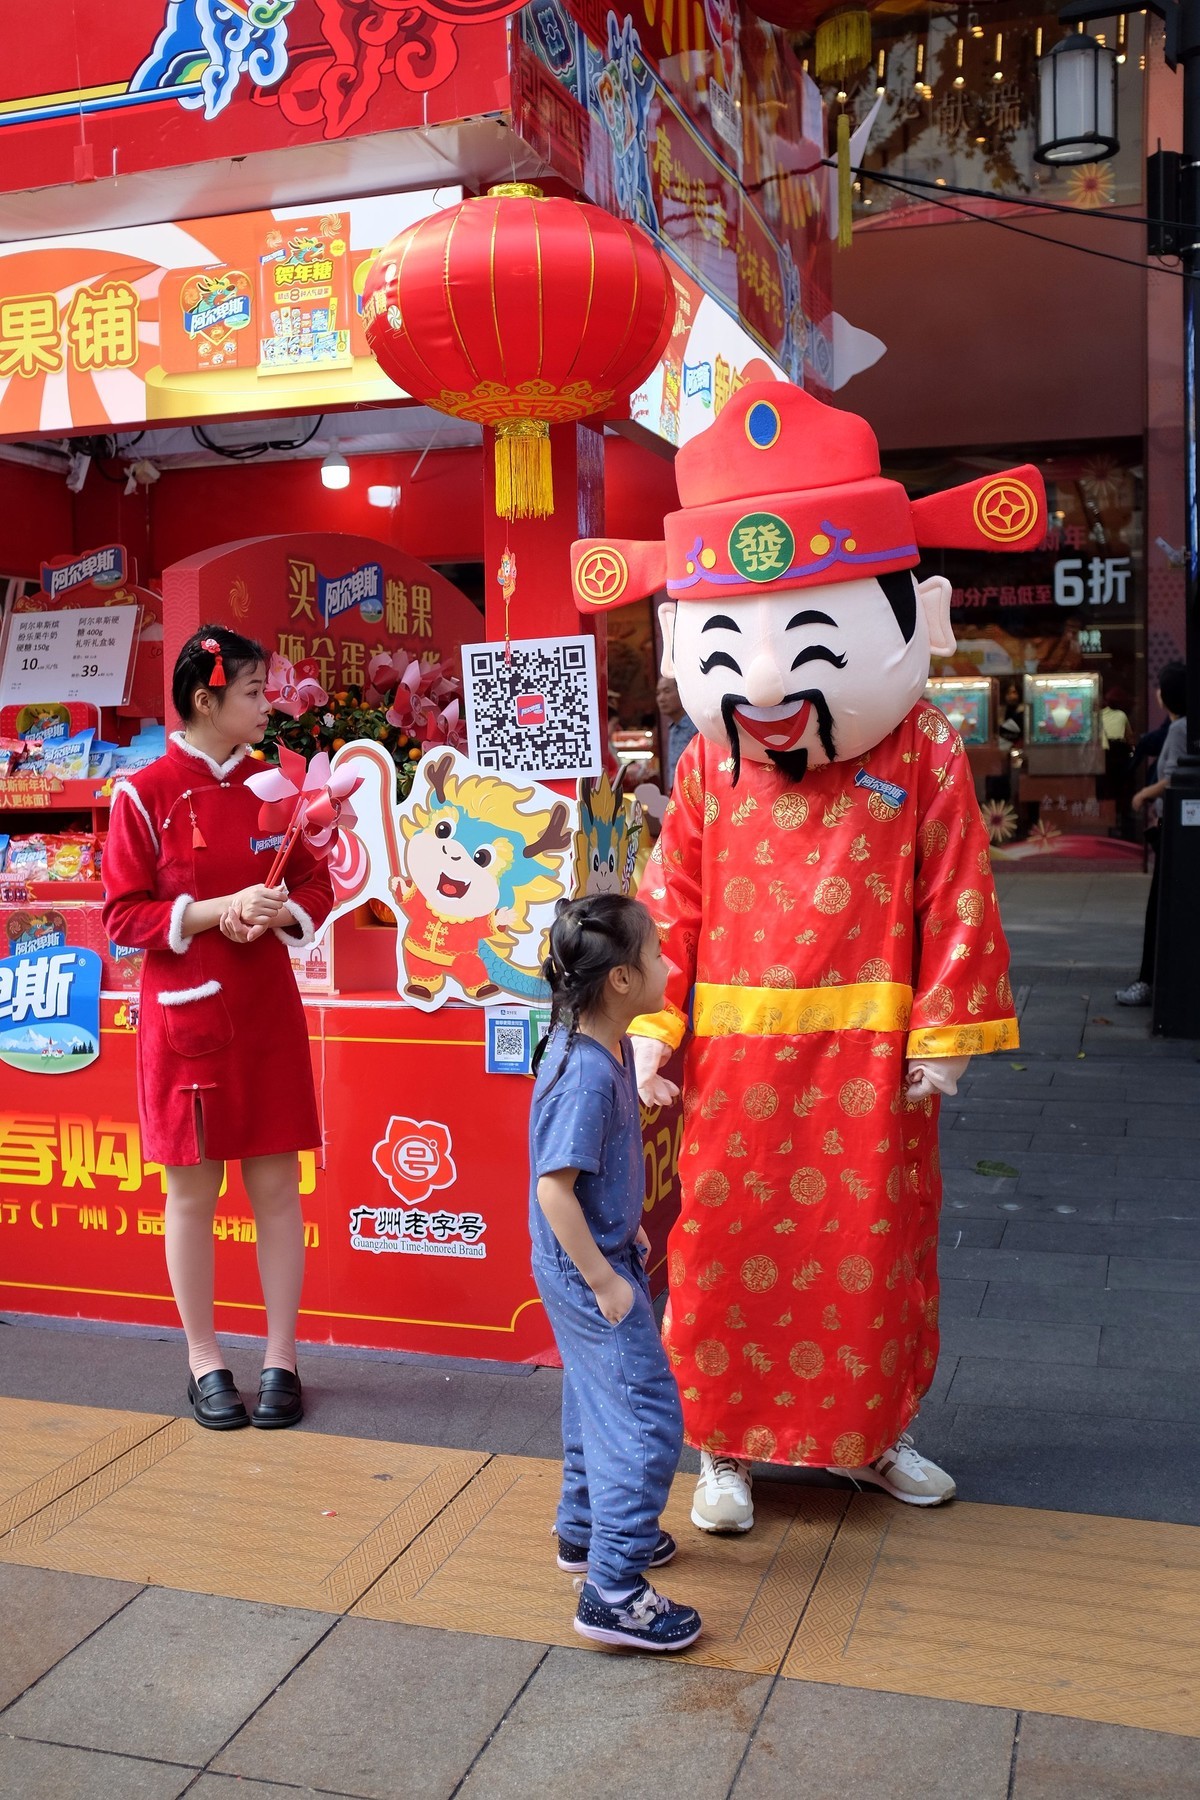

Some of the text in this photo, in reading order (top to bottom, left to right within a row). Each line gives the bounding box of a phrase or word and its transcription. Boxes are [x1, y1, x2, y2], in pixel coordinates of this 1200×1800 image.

[274, 260, 333, 286] 贺年糖
[0, 288, 135, 373] 果铺
[735, 522, 786, 572] 發
[51, 549, 115, 600] 阿尔卑斯
[1054, 557, 1131, 606] 6折
[855, 775, 905, 799] 阿尔卑斯
[352, 1208, 483, 1239] 广州老字号
[353, 1237, 484, 1256] Guangzhou Time-honored Brand
